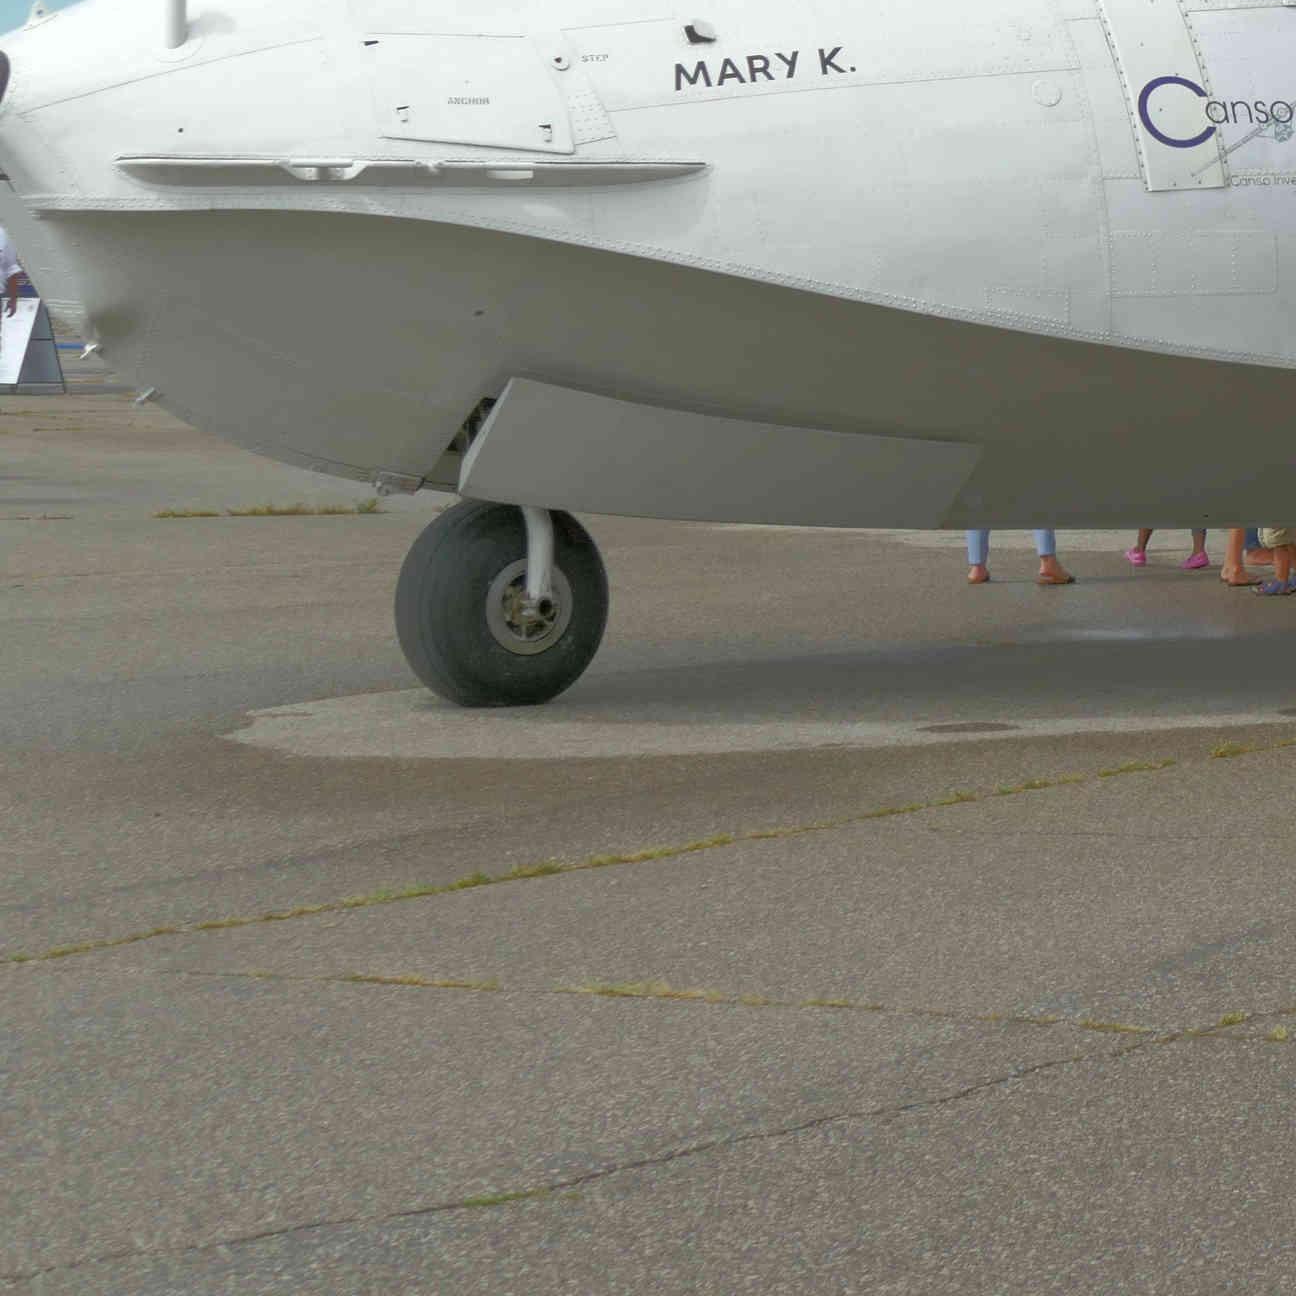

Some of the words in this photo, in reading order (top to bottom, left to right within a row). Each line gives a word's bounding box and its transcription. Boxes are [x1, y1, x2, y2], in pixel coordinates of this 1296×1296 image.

[674, 49, 800, 92] MARY
[817, 46, 858, 75] K.
[447, 96, 491, 105] ANCHOR
[1137, 75, 1294, 149] Canso
[1230, 174, 1272, 187] Canso
